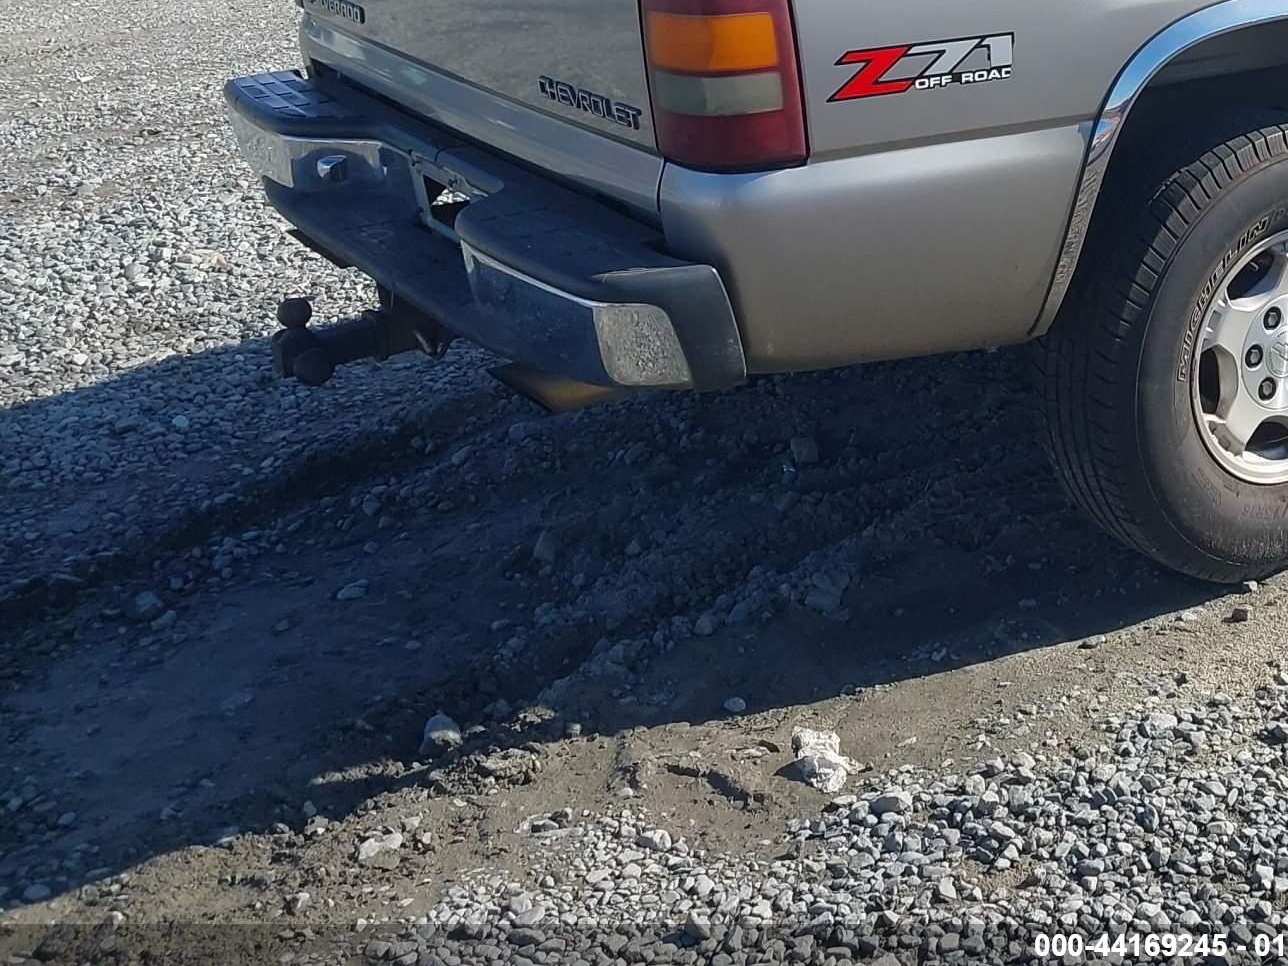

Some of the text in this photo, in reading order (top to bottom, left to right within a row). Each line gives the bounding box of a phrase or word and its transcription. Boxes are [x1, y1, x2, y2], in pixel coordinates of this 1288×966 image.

[826, 31, 1015, 103] Z71
[915, 67, 1012, 90] OFF ROAD
[536, 75, 642, 130] CHEVROLET
[1176, 216, 1270, 383] MICHELIN
